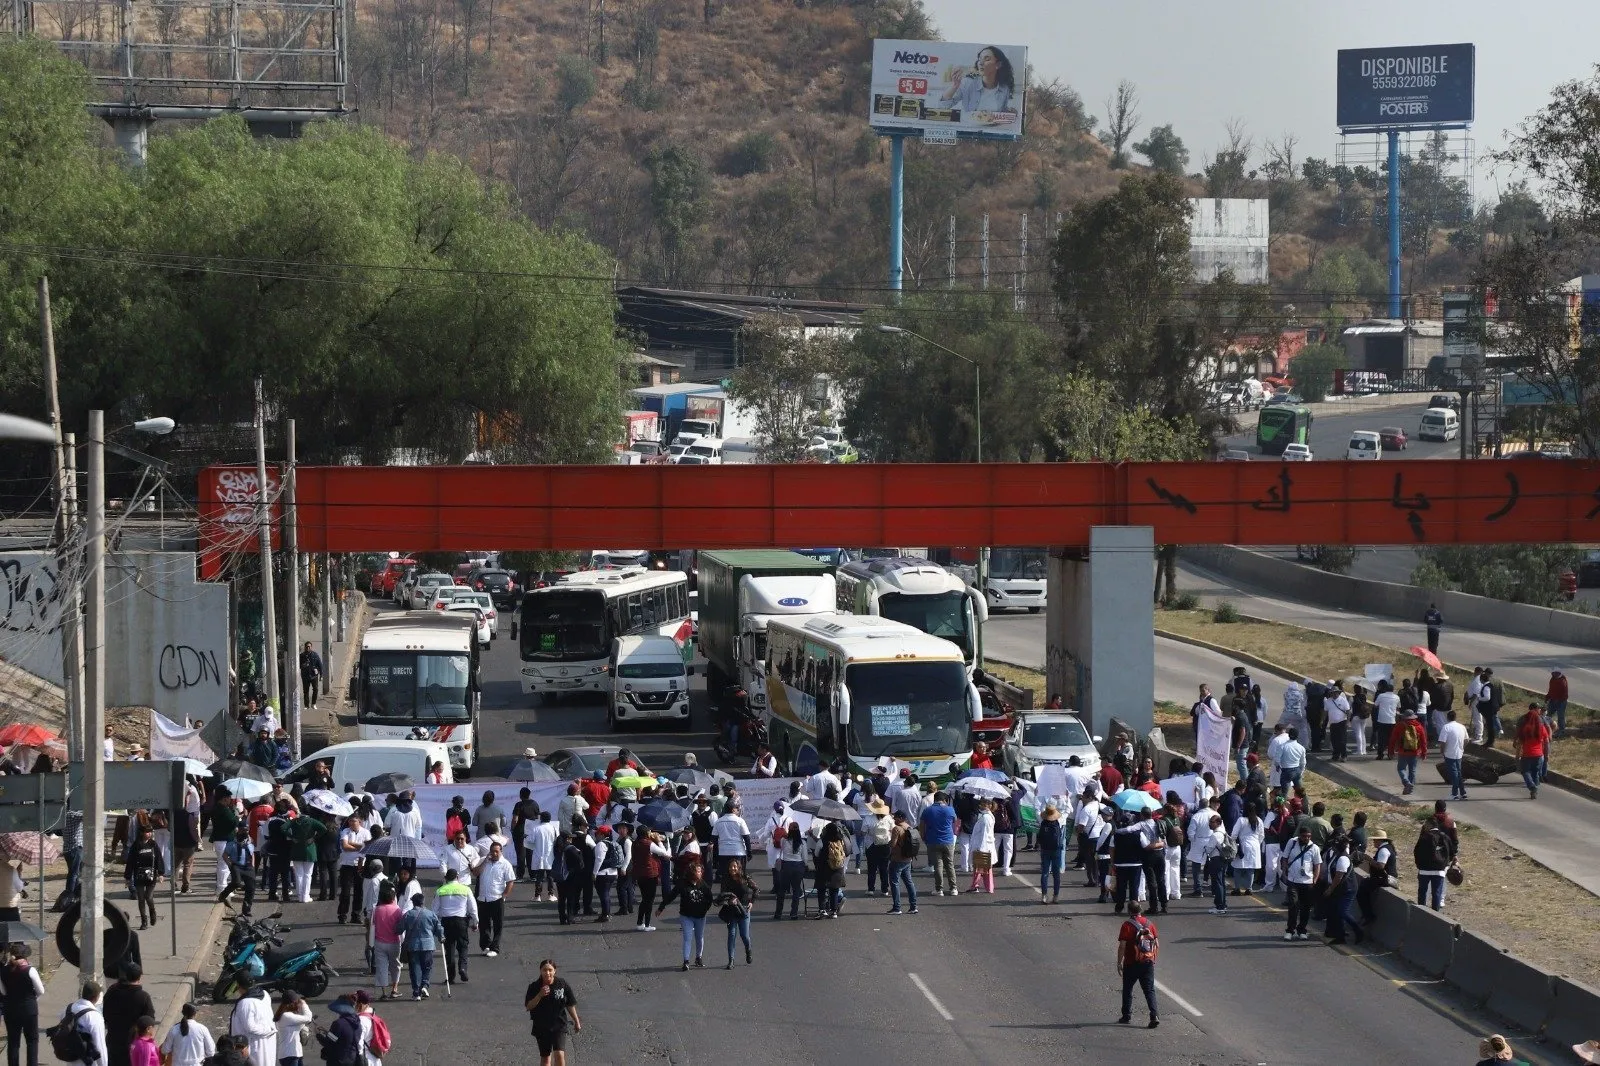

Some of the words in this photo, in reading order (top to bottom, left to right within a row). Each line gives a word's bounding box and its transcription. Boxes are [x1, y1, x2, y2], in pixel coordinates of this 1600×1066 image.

[893, 51, 929, 64] Neto
[1361, 55, 1448, 76] DISPONIBLE
[1372, 75, 1437, 89] 5559322086
[1380, 102, 1423, 116] POSTER
[159, 644, 221, 690] CDN
